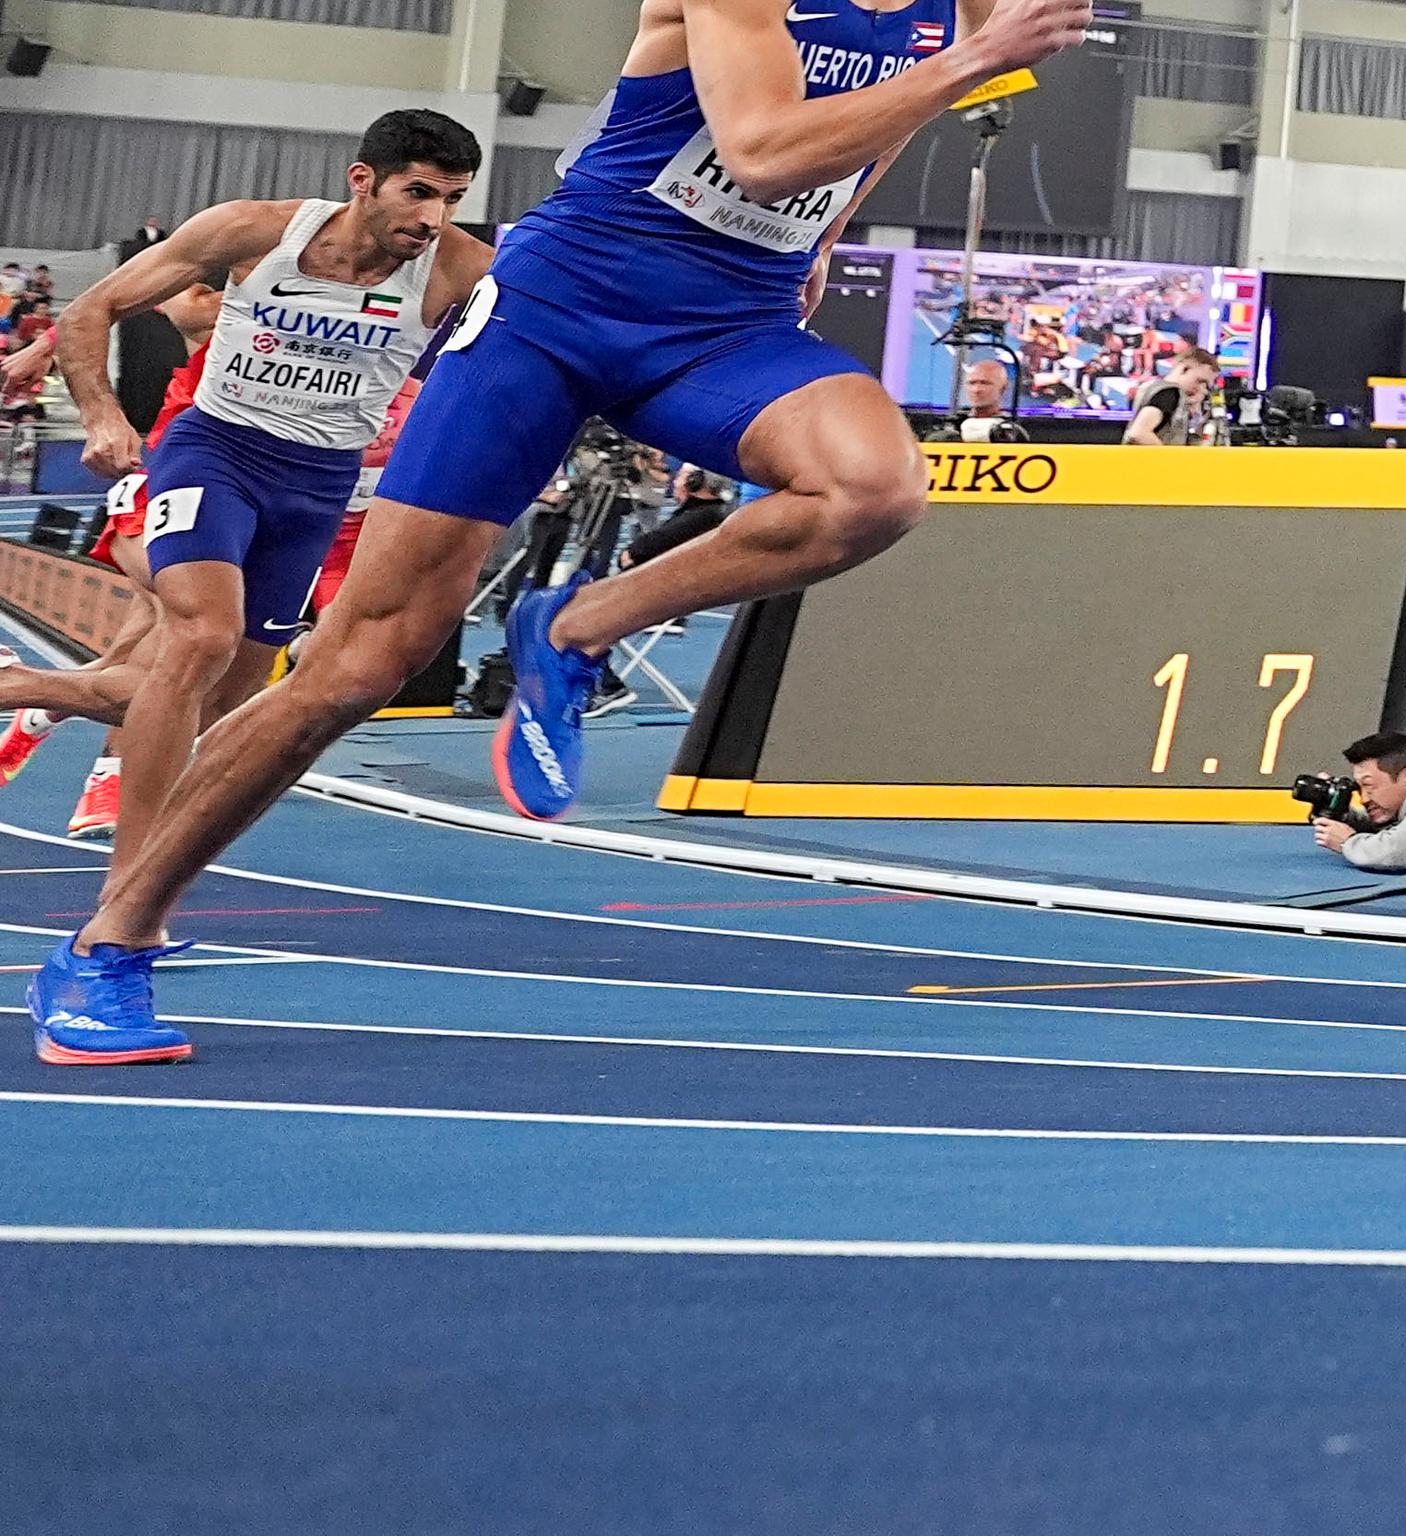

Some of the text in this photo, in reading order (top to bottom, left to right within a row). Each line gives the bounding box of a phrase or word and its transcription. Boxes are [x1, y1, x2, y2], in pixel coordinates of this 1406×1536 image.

[798, 41, 874, 90] UERTO
[253, 302, 400, 348] KUWAIT
[225, 353, 362, 397] ALZOFAIRI
[154, 498, 171, 531] 3
[1151, 652, 1315, 775] 1.7
